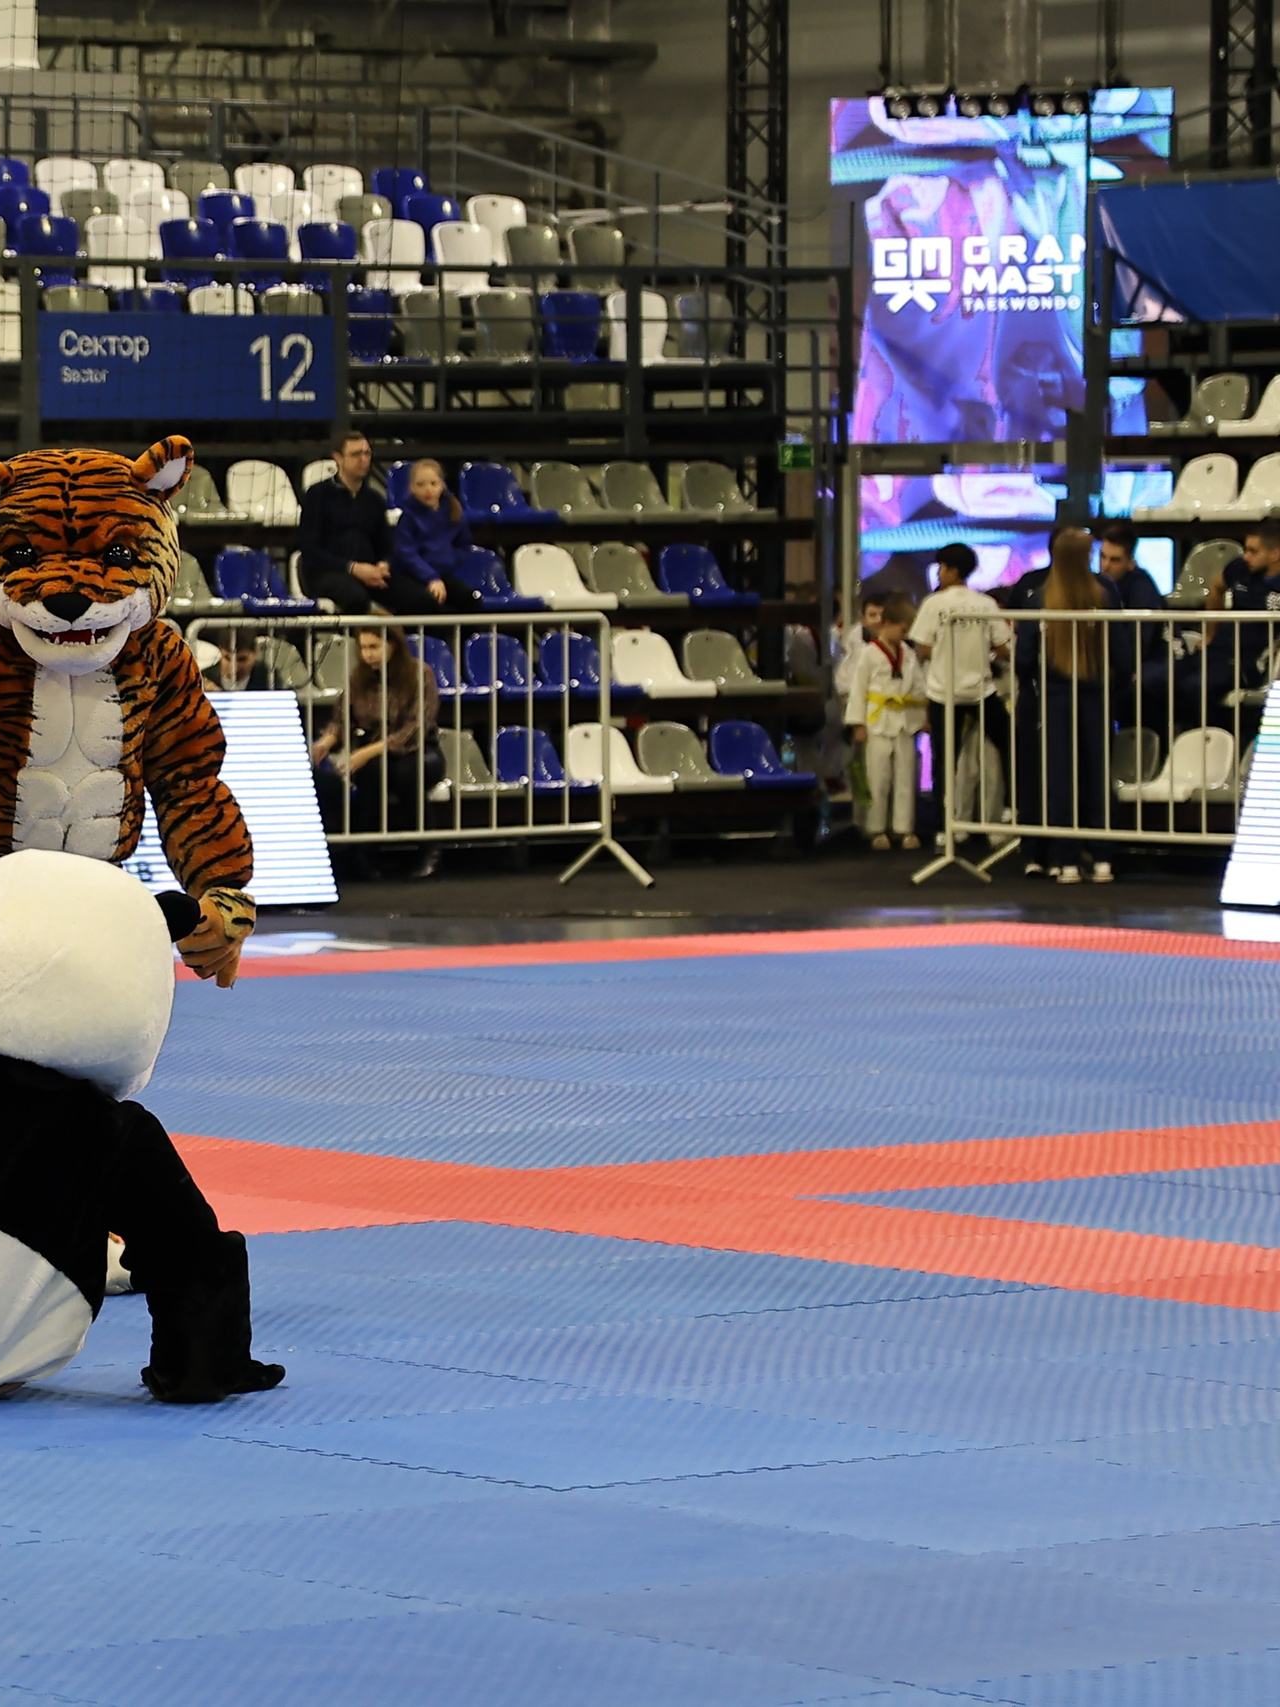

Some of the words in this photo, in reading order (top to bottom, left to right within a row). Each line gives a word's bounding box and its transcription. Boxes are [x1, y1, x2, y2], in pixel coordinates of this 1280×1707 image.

[963, 234, 1086, 265] GRA
[962, 264, 1082, 295] MAST
[962, 296, 1082, 312] TAEKWONDO
[59, 329, 150, 362] Сектор
[249, 333, 316, 401] 12
[61, 365, 109, 383] Sector
